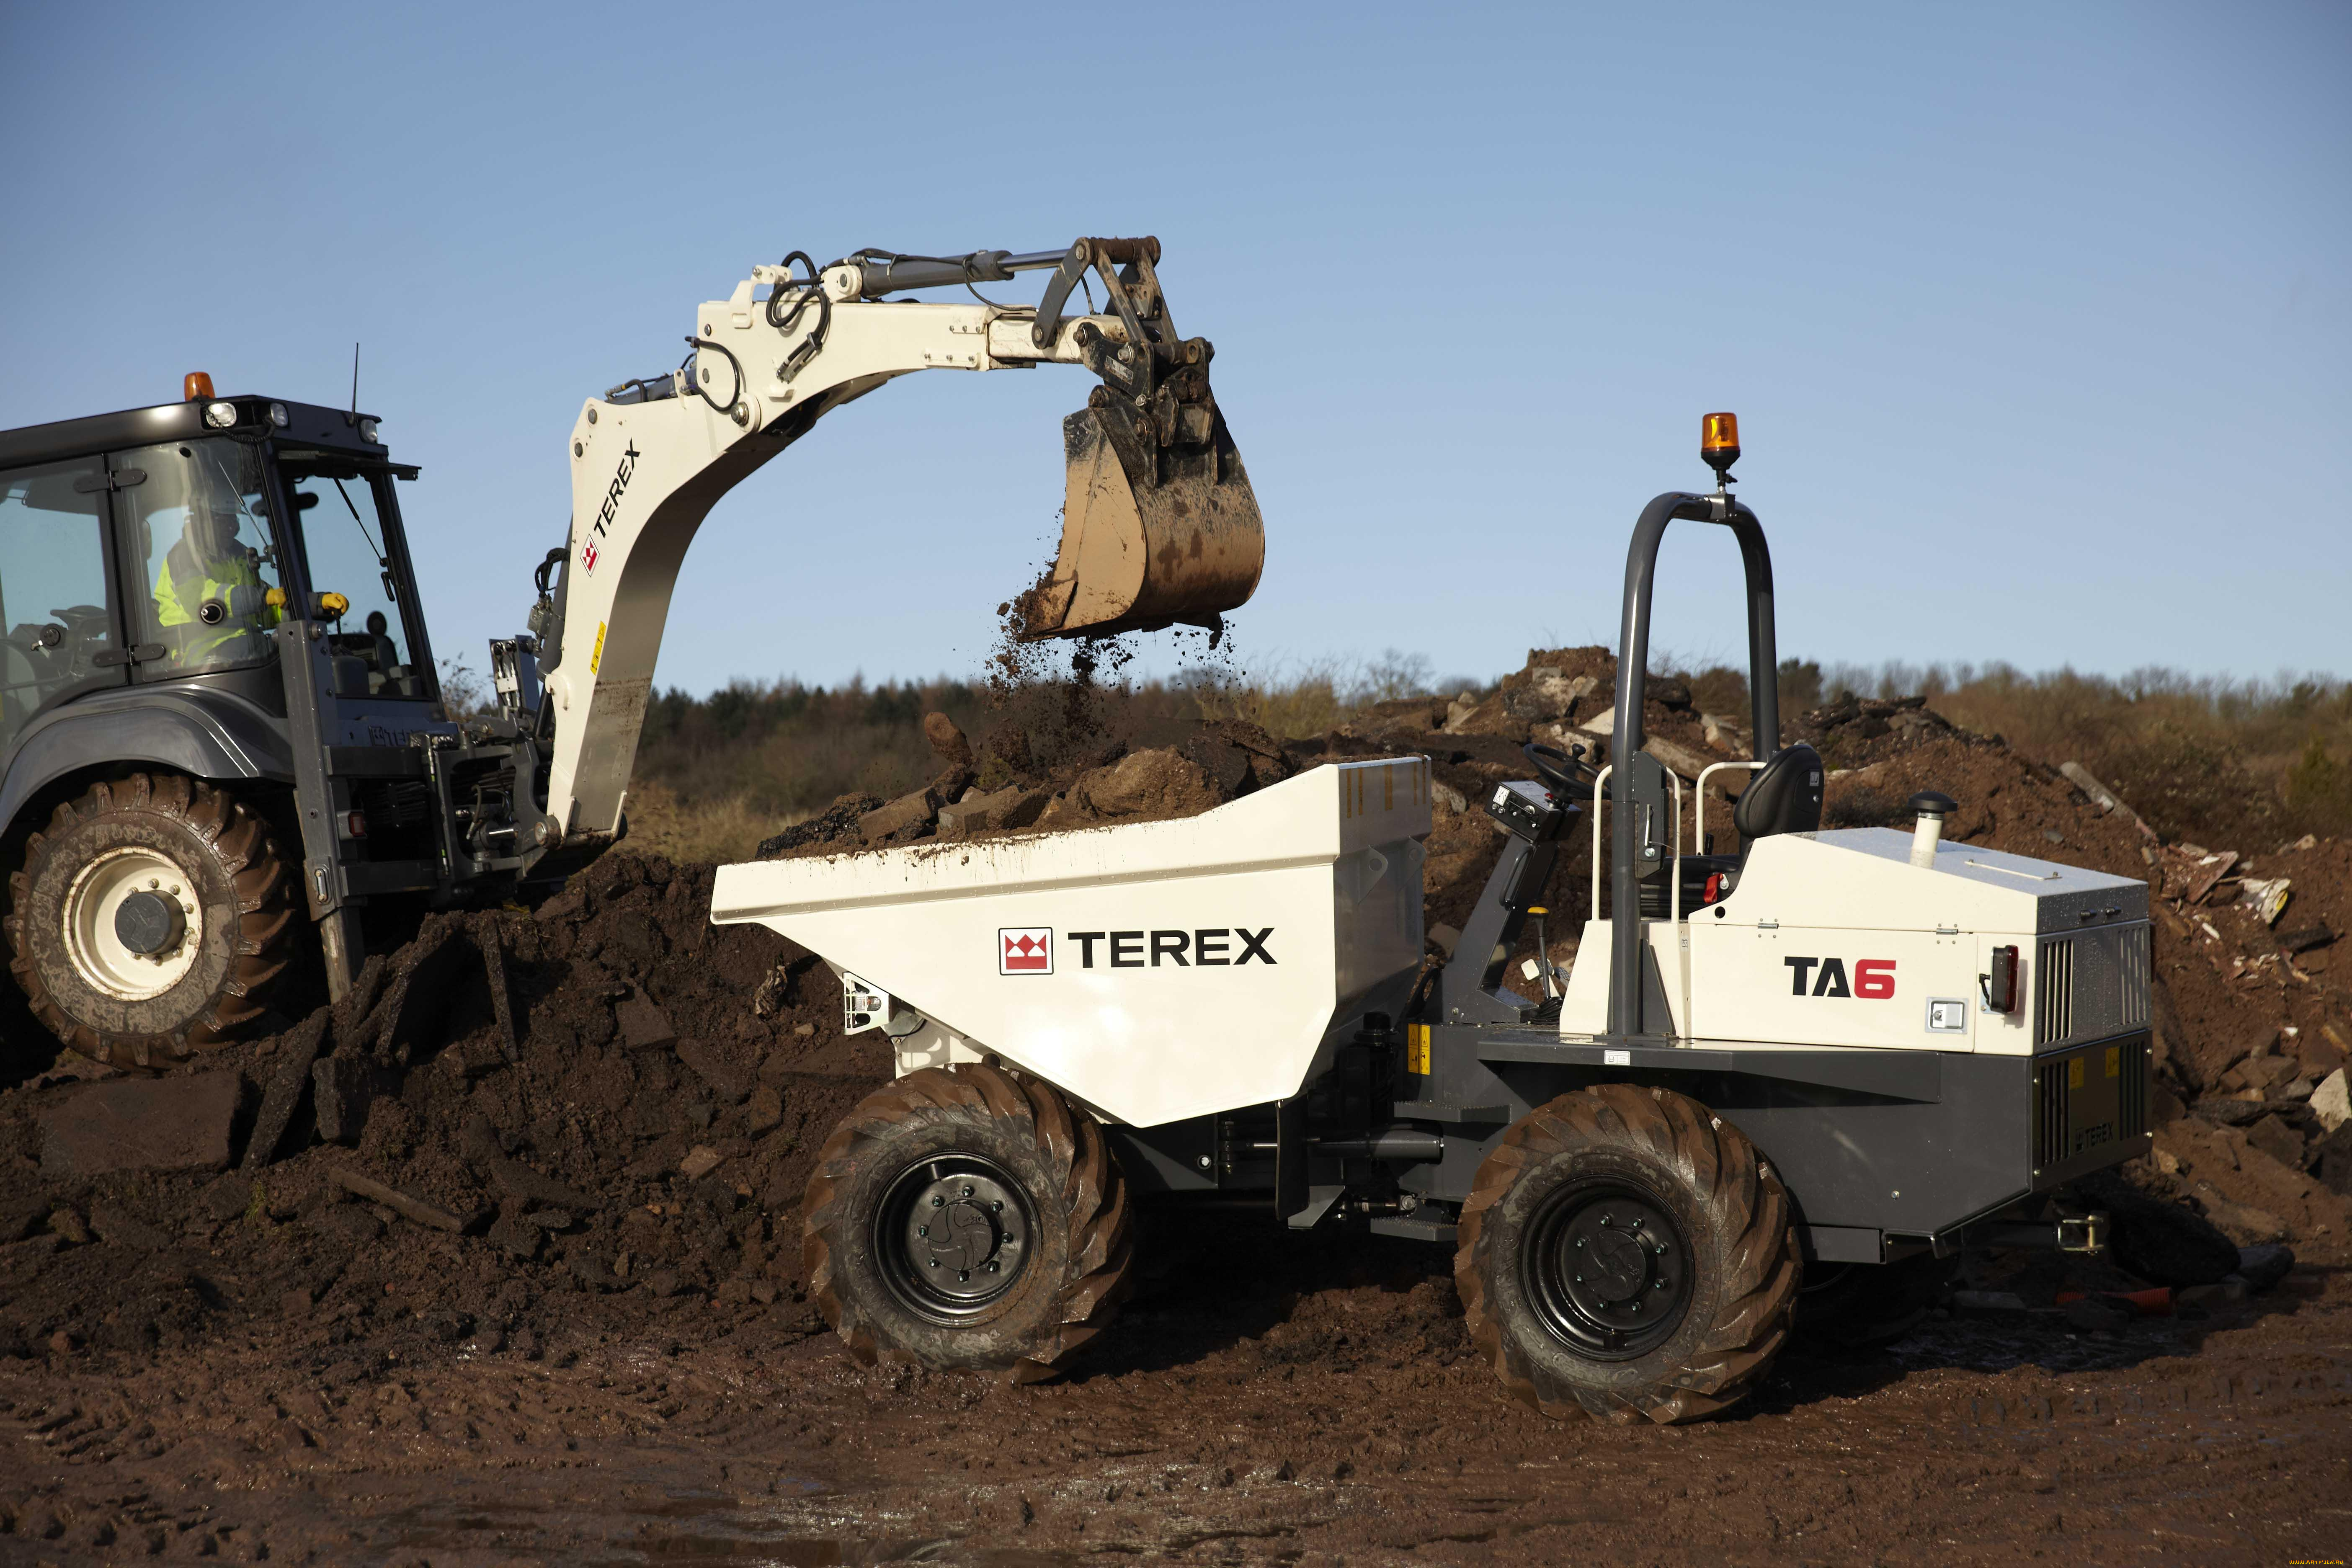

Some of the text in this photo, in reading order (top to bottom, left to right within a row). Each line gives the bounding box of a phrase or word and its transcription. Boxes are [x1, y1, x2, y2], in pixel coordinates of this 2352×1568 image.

[594, 437, 640, 539] TEREX
[1068, 927, 1278, 968] TEREX
[1784, 956, 1896, 999] TA6
[2084, 1121, 2114, 1148] TEREX
